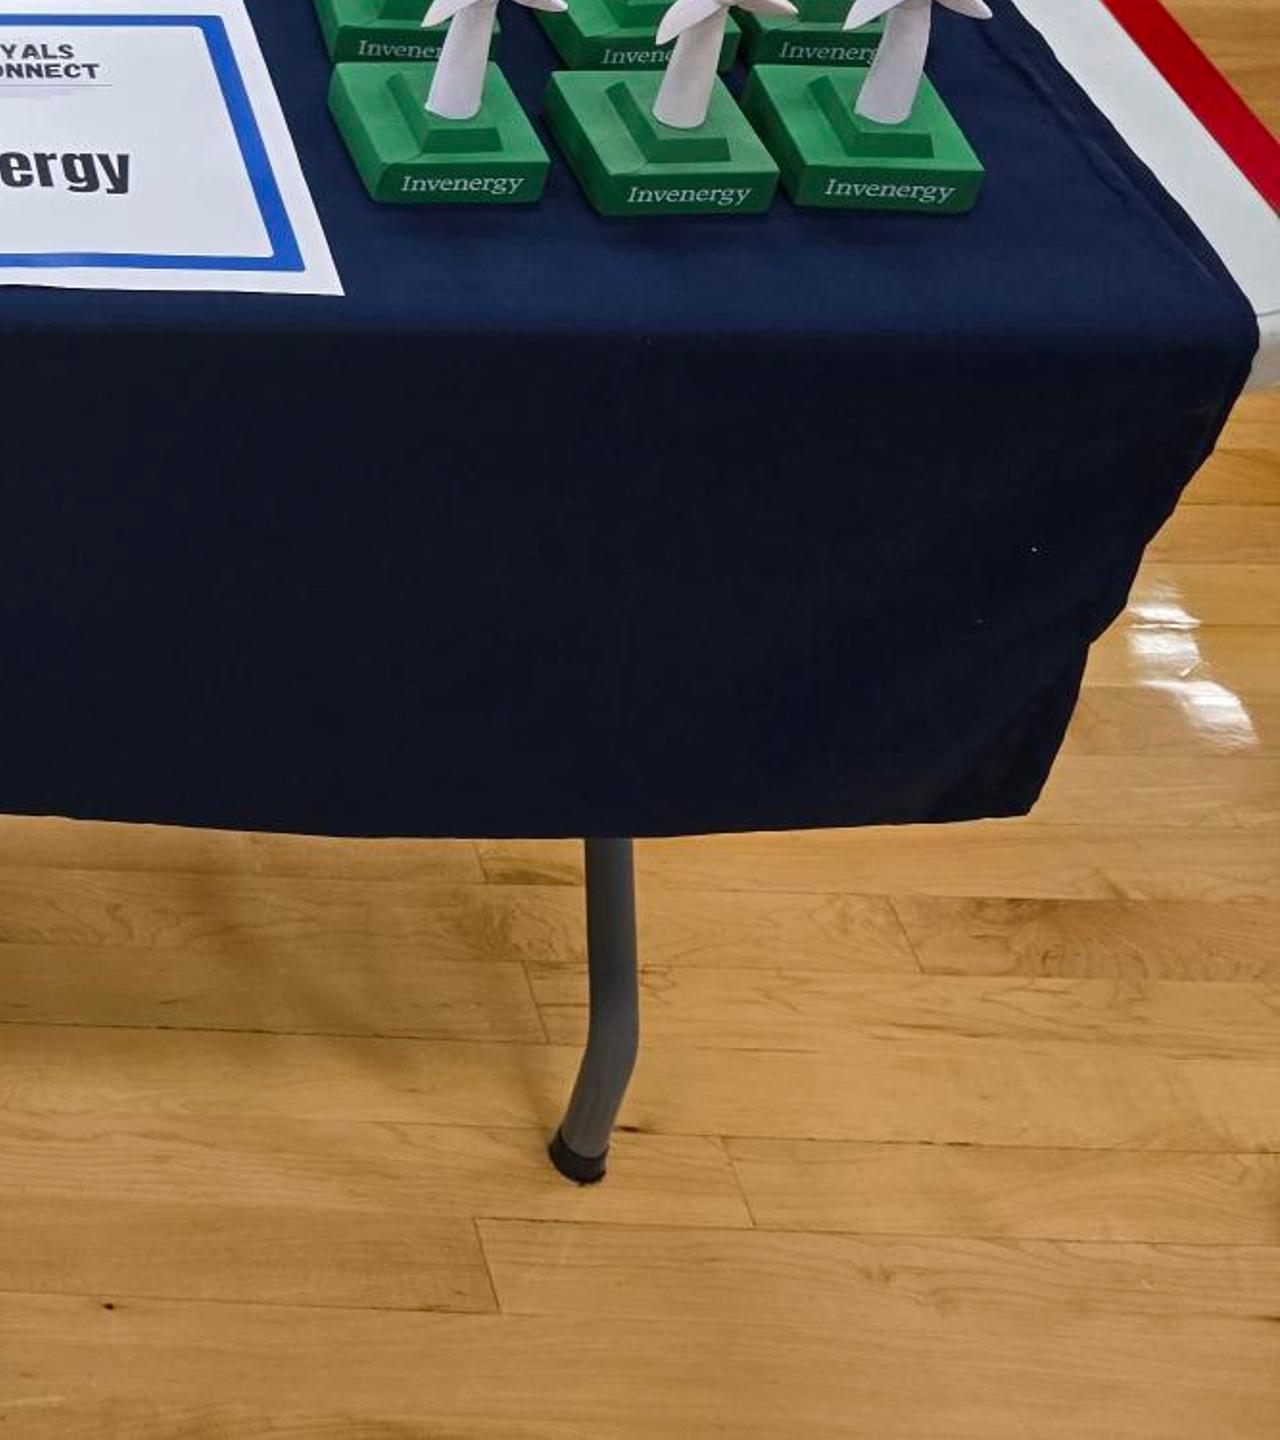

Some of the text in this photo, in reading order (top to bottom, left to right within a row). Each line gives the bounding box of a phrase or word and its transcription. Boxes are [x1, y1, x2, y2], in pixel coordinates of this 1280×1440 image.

[401, 174, 524, 195] Invenergy
[823, 177, 956, 204] Invenergy
[627, 185, 752, 206] Invenergy
